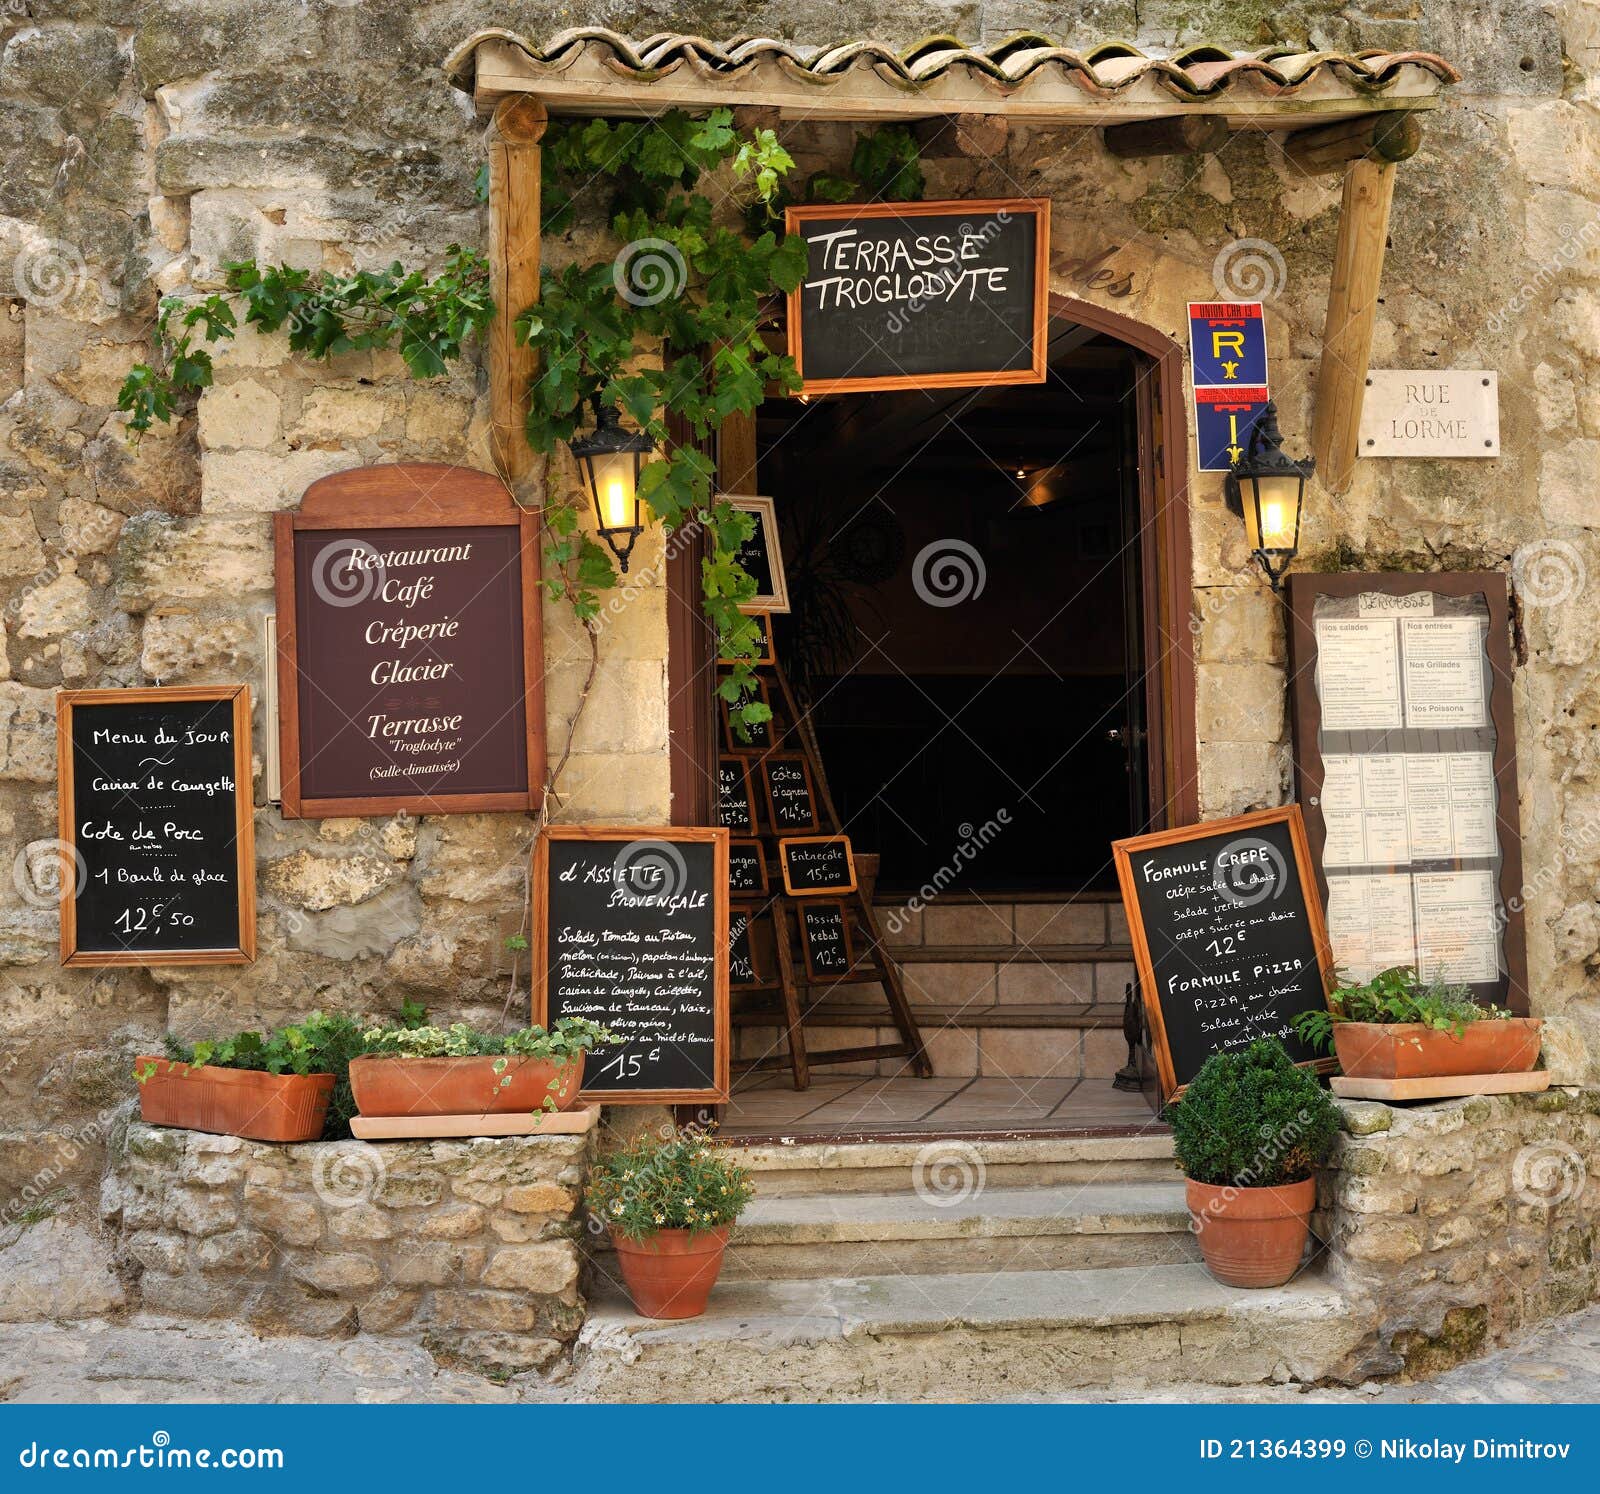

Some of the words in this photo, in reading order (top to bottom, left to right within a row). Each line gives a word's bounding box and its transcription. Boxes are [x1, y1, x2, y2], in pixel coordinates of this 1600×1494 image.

[807, 228, 985, 273] TERRASSE
[805, 267, 1009, 310] TROGLODYTE
[1212, 331, 1245, 358] R
[1405, 384, 1450, 405] RUE
[1419, 407, 1438, 417] DE
[1391, 419, 1468, 440] LORME
[345, 543, 472, 571] Restaurant
[382, 576, 434, 609] Café
[365, 616, 460, 649] Crêperie
[1339, 622, 1369, 631] salades
[1407, 622, 1423, 630] Nos
[370, 658, 453, 686] Glacier
[1409, 661, 1424, 669] Nos
[1426, 661, 1460, 669] Grillades
[1411, 704, 1427, 712] Nos
[1429, 704, 1464, 712] Poissons
[367, 713, 463, 739] Terrasse
[93, 728, 147, 745] Menu
[155, 728, 178, 745] du
[389, 738, 462, 755] "Troglodyte"
[369, 766, 401, 780] (Salle
[402, 759, 461, 776] climatisée)
[147, 776, 164, 790] de
[81, 820, 124, 840] Cote
[132, 821, 155, 840] de
[164, 822, 204, 841] Porc
[791, 849, 844, 862] Entrecôte
[1143, 859, 1207, 882] FORMULE
[1217, 846, 1270, 868] CREPE
[95, 868, 109, 885] 1
[118, 866, 166, 883] Boule
[170, 869, 186, 882] de
[193, 869, 228, 886] glace
[1166, 883, 1197, 900] crêpe
[1200, 879, 1227, 893] salée
[1233, 879, 1246, 888] au
[1249, 872, 1277, 884] choix
[1173, 905, 1209, 922] Salade
[1214, 899, 1247, 914] verte
[1175, 926, 1205, 941] crêpe
[1209, 919, 1246, 933] sucrée
[1250, 916, 1264, 925] au
[1268, 910, 1297, 922] choix
[602, 929, 640, 943] tomates
[645, 934, 659, 942] au
[559, 949, 596, 961] melon
[593, 986, 606, 995] de
[1168, 970, 1241, 994] FORMULE
[1248, 991, 1264, 1001] au
[1268, 983, 1302, 998] choix
[608, 1003, 622, 1012] de
[1200, 1017, 1241, 1033] Salade
[639, 1034, 653, 1043] au
